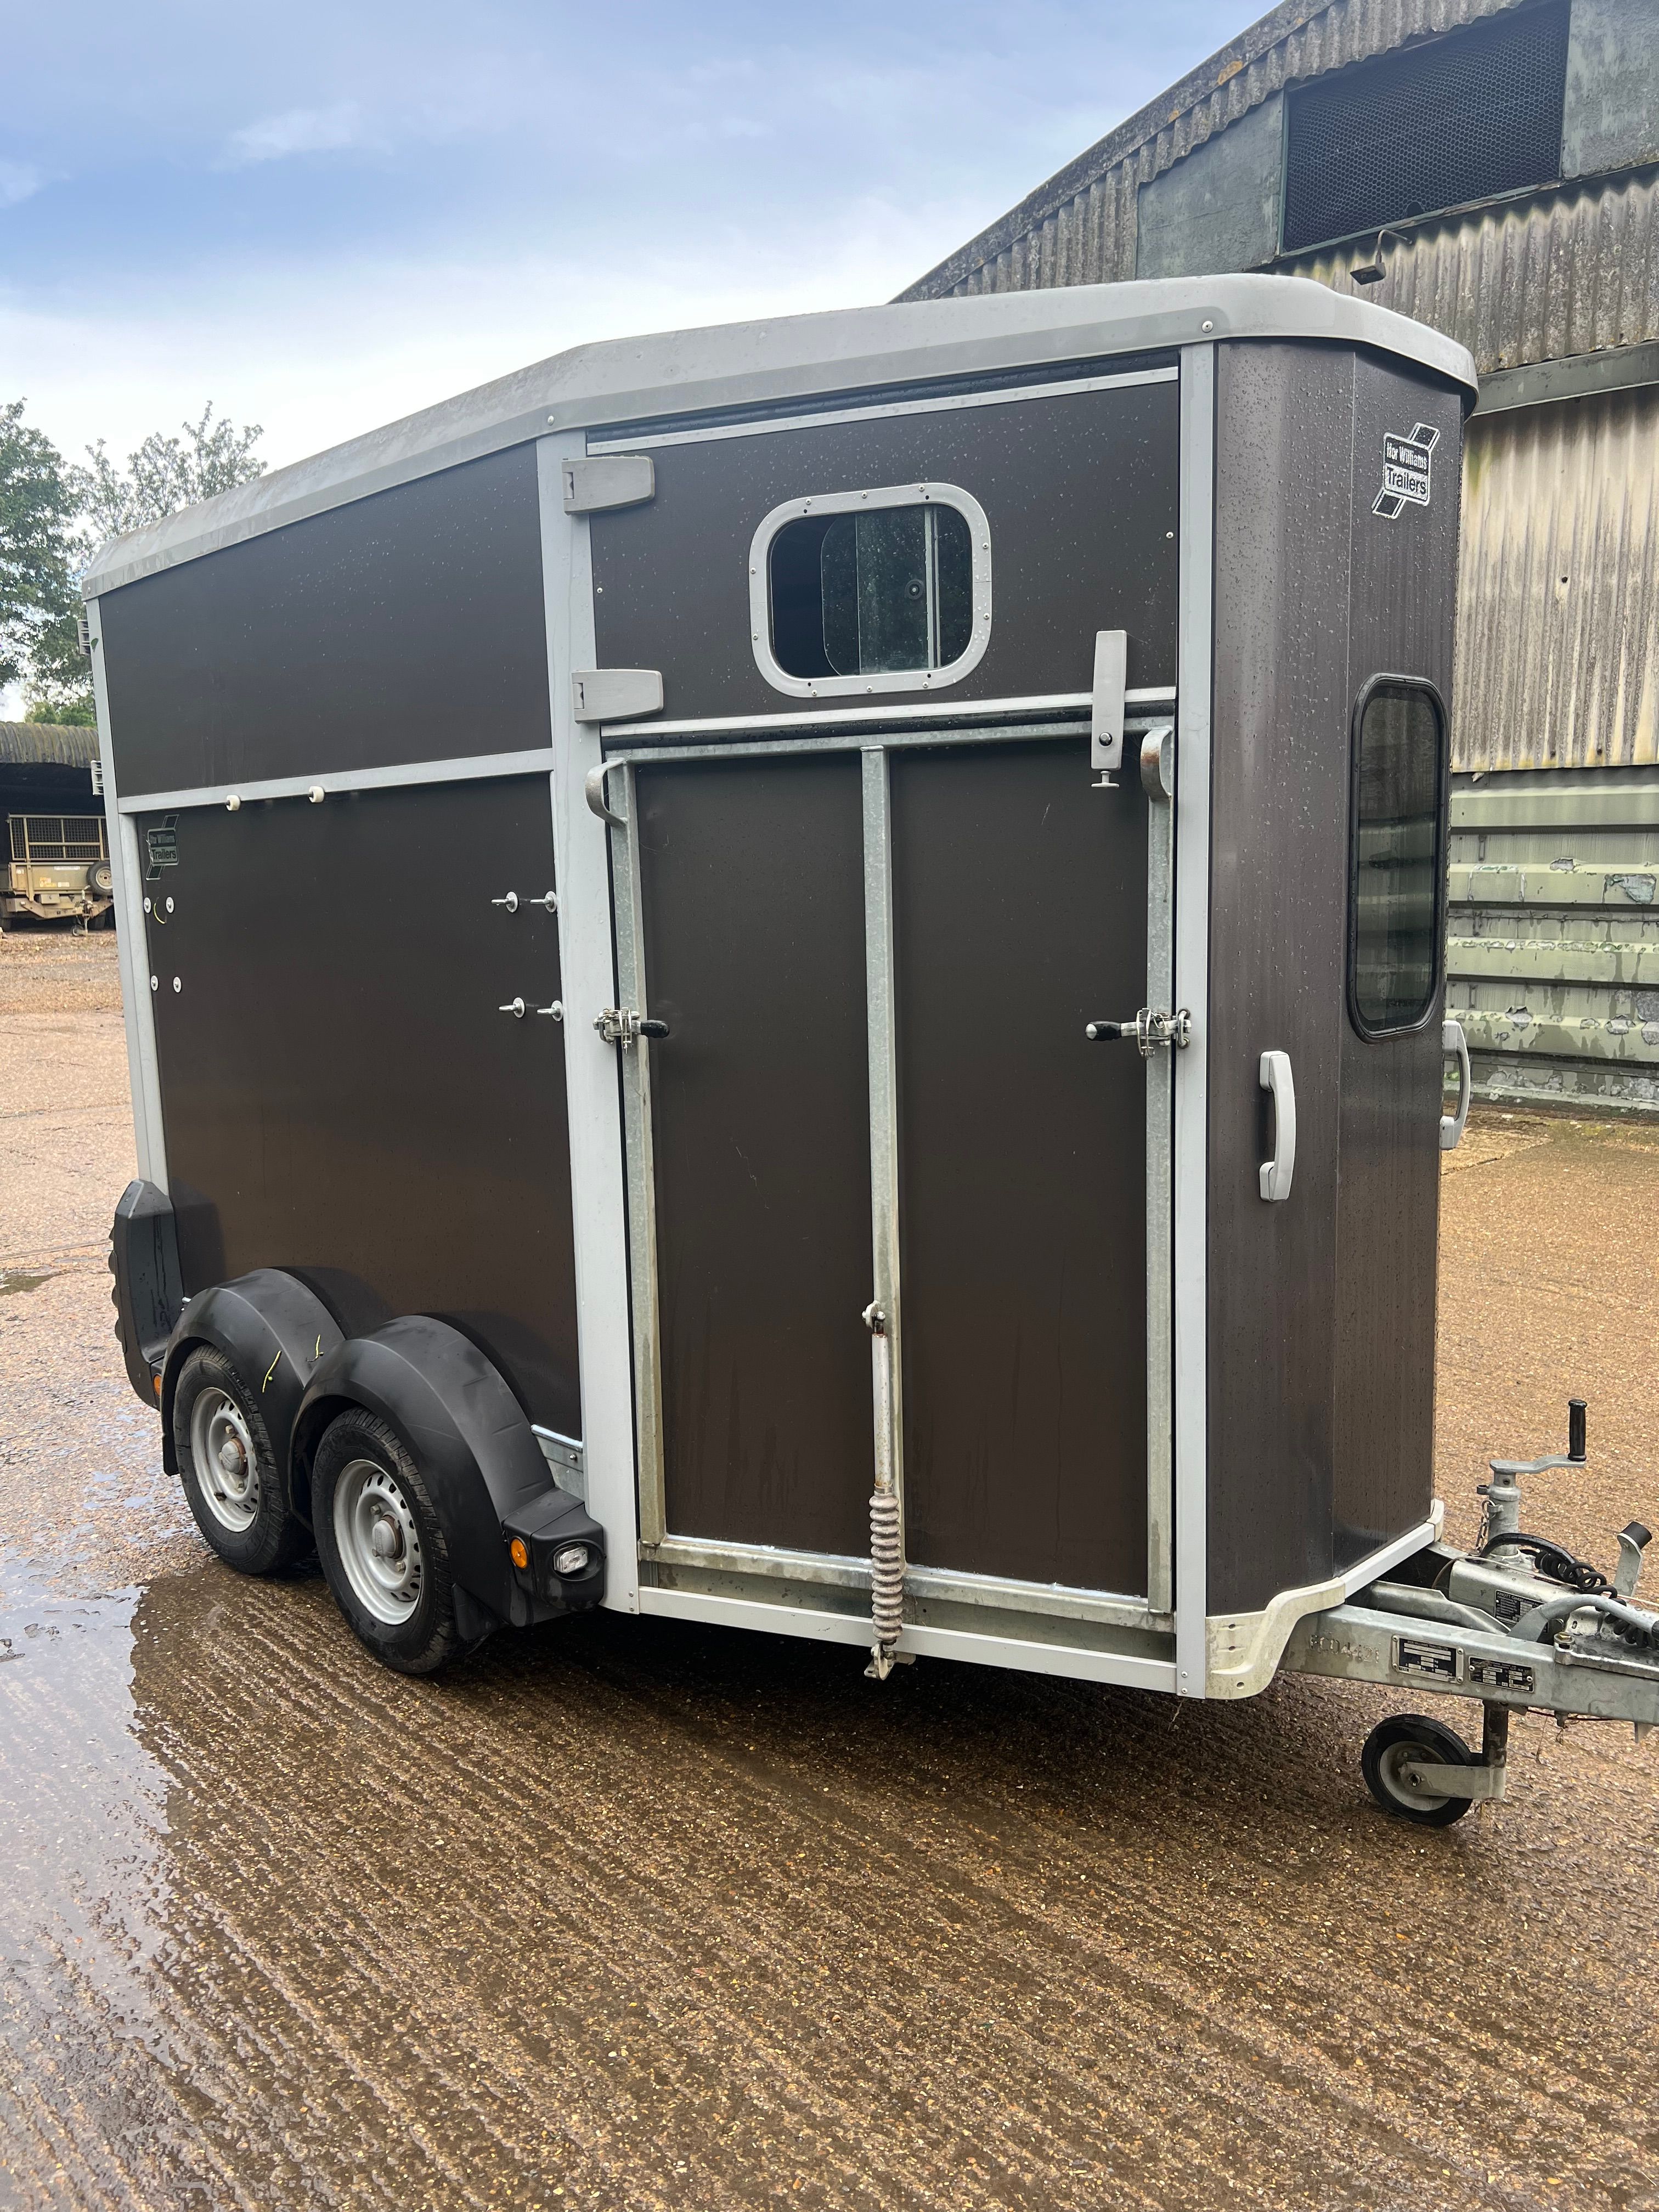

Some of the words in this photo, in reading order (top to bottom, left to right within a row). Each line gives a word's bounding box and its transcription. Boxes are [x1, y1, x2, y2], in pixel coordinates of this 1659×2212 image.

[1399, 446, 1427, 470] Williams
[1387, 466, 1426, 494] Trailers
[151, 848, 177, 860] Trailers
